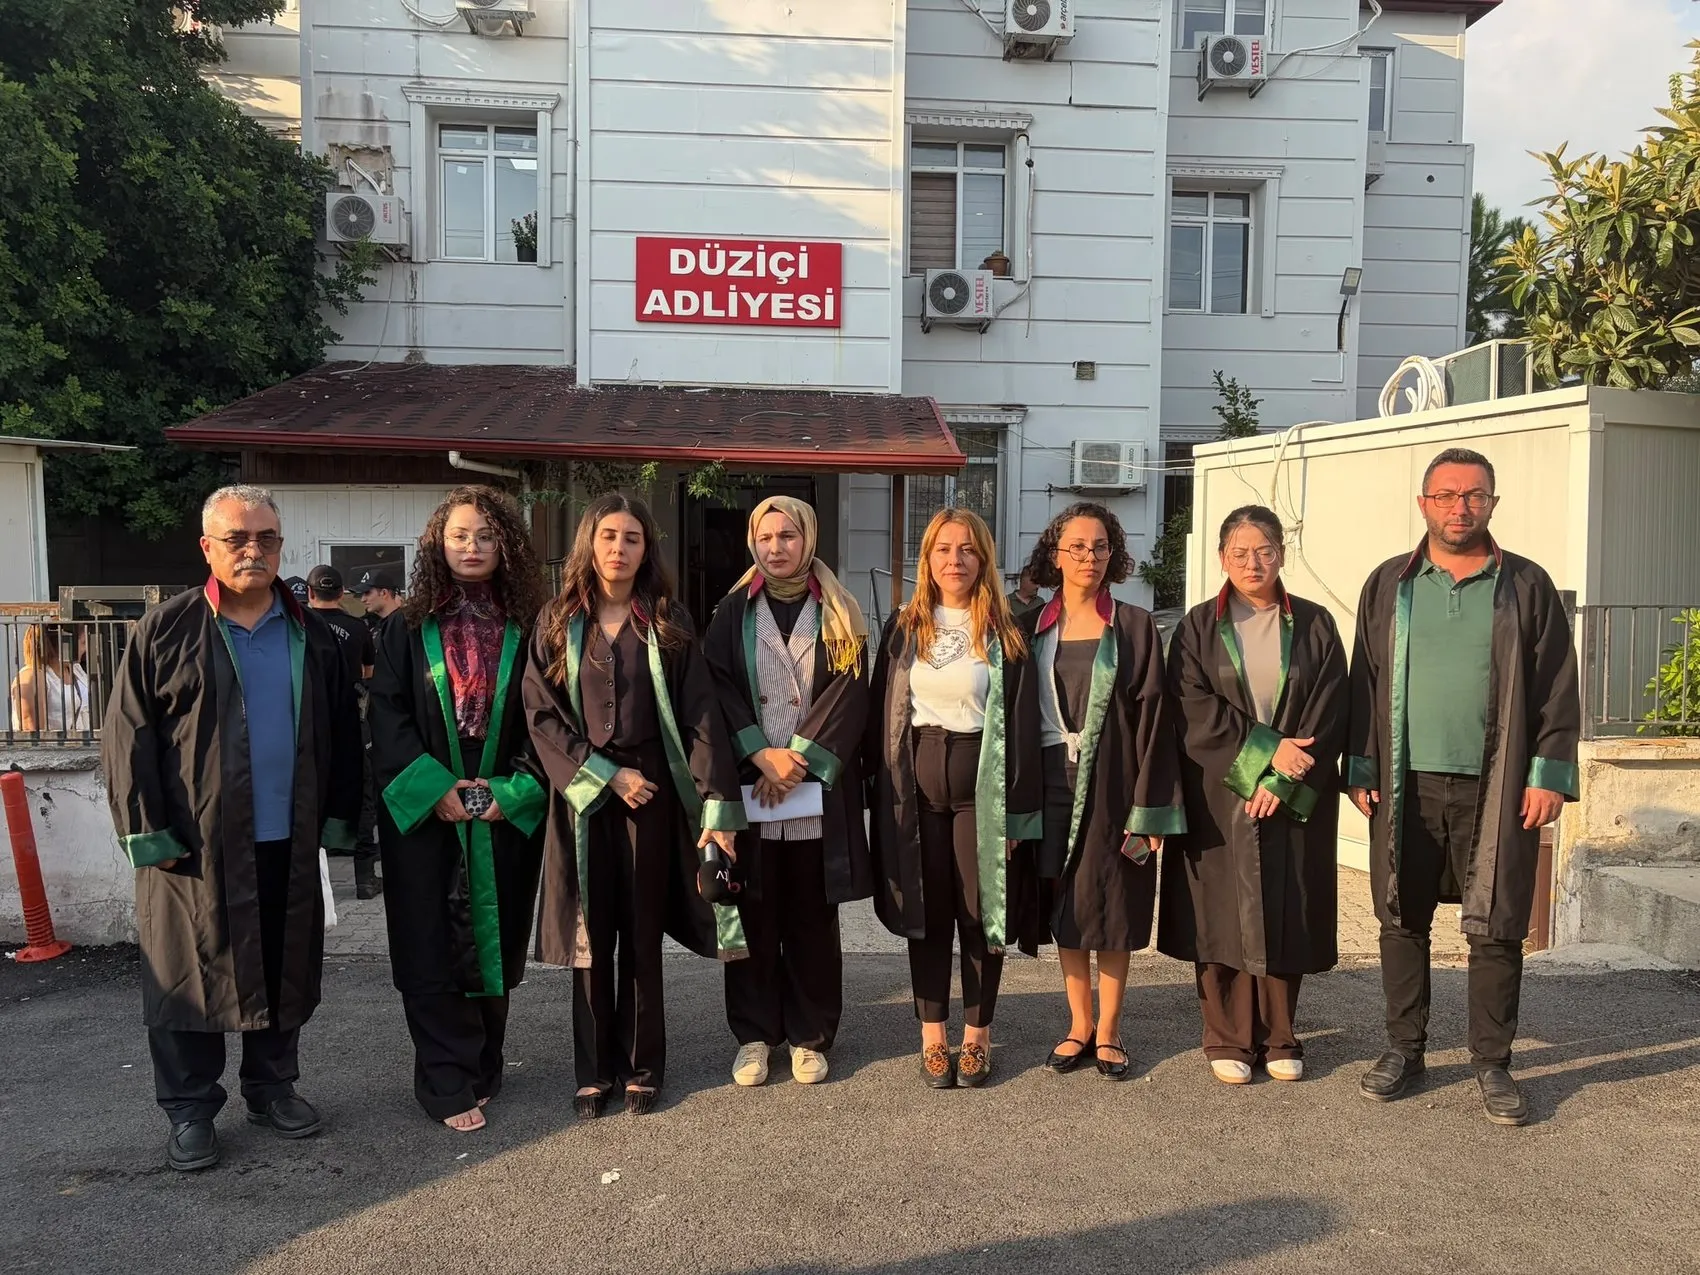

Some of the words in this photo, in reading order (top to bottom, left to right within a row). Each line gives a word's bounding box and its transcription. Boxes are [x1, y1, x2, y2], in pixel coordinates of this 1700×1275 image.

[1251, 40, 1260, 75] VESTEL
[669, 242, 809, 285] DÜZİÇİ
[642, 284, 834, 321] ADLİYESİ
[975, 275, 985, 314] VESTEL
[328, 622, 350, 640] VVET
